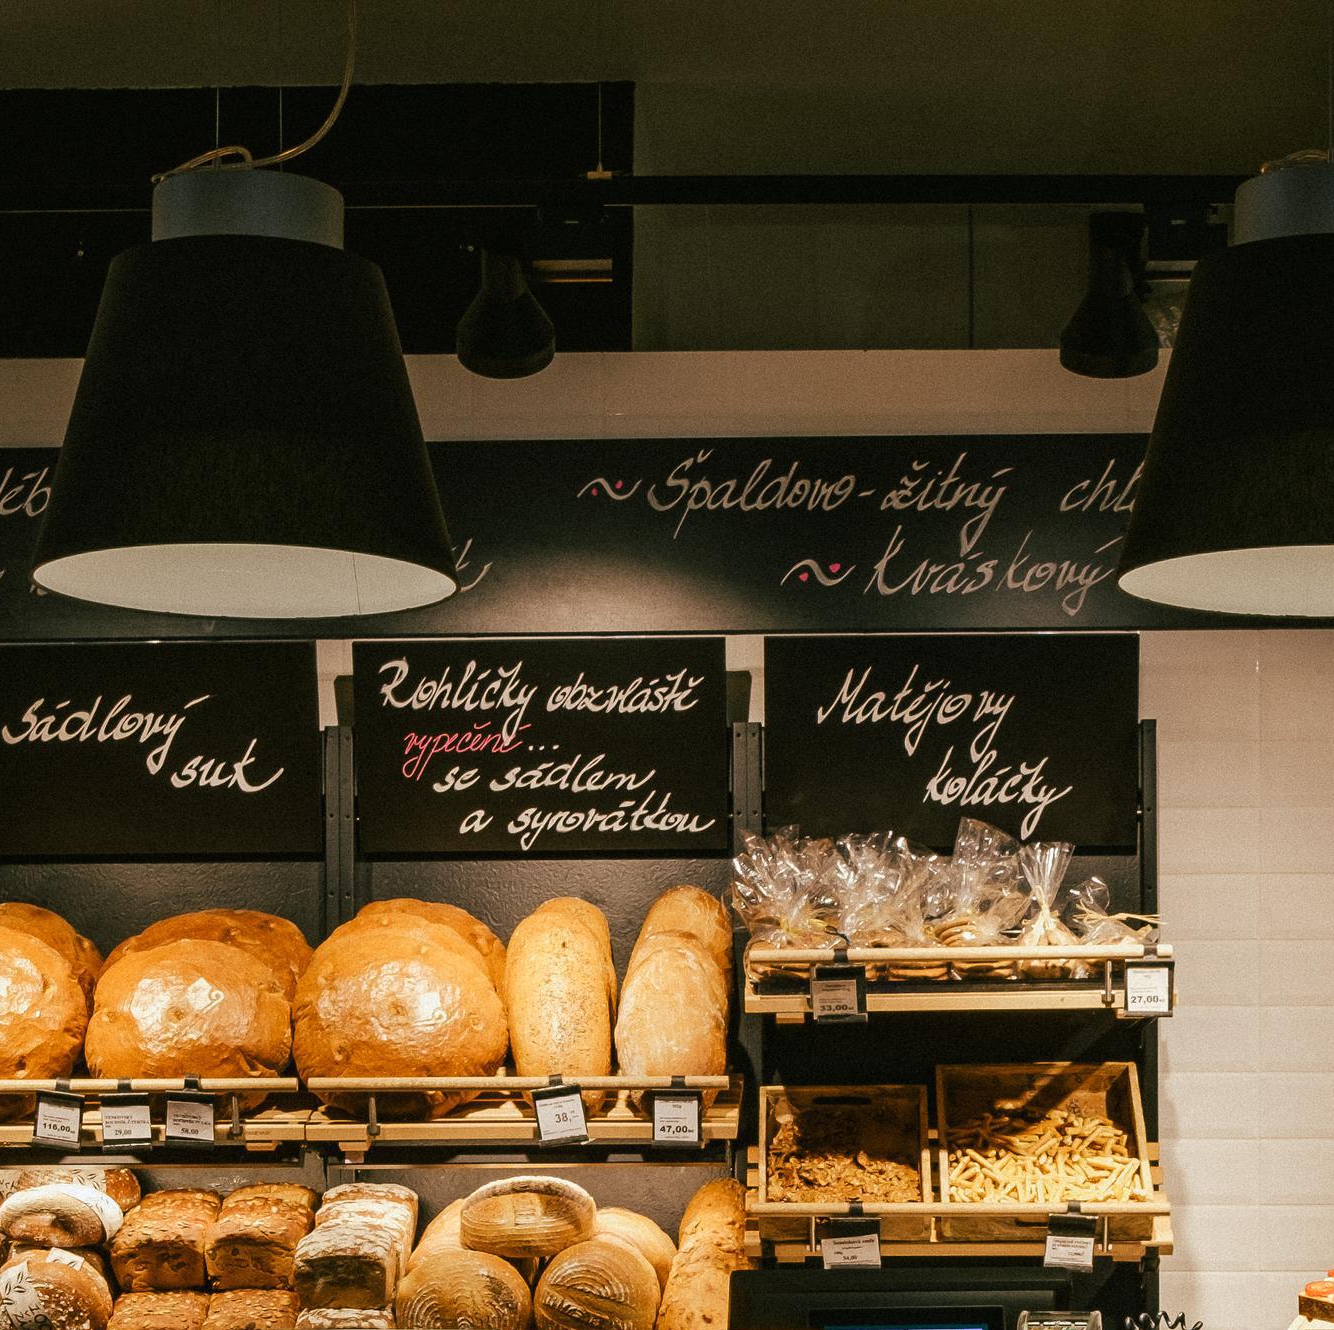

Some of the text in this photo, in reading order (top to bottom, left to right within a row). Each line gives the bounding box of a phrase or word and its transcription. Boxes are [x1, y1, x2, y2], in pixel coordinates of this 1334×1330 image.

[864, 524, 1124, 617] Kváskový
[1, 693, 217, 776] Sádlový
[378, 656, 538, 747] Rohlíčky
[817, 663, 1017, 763] Matějovy
[170, 737, 285, 793] suk
[433, 753, 657, 793] se sádlem
[922, 745, 1073, 841] koláčky
[459, 790, 717, 852] a syrovátkou
